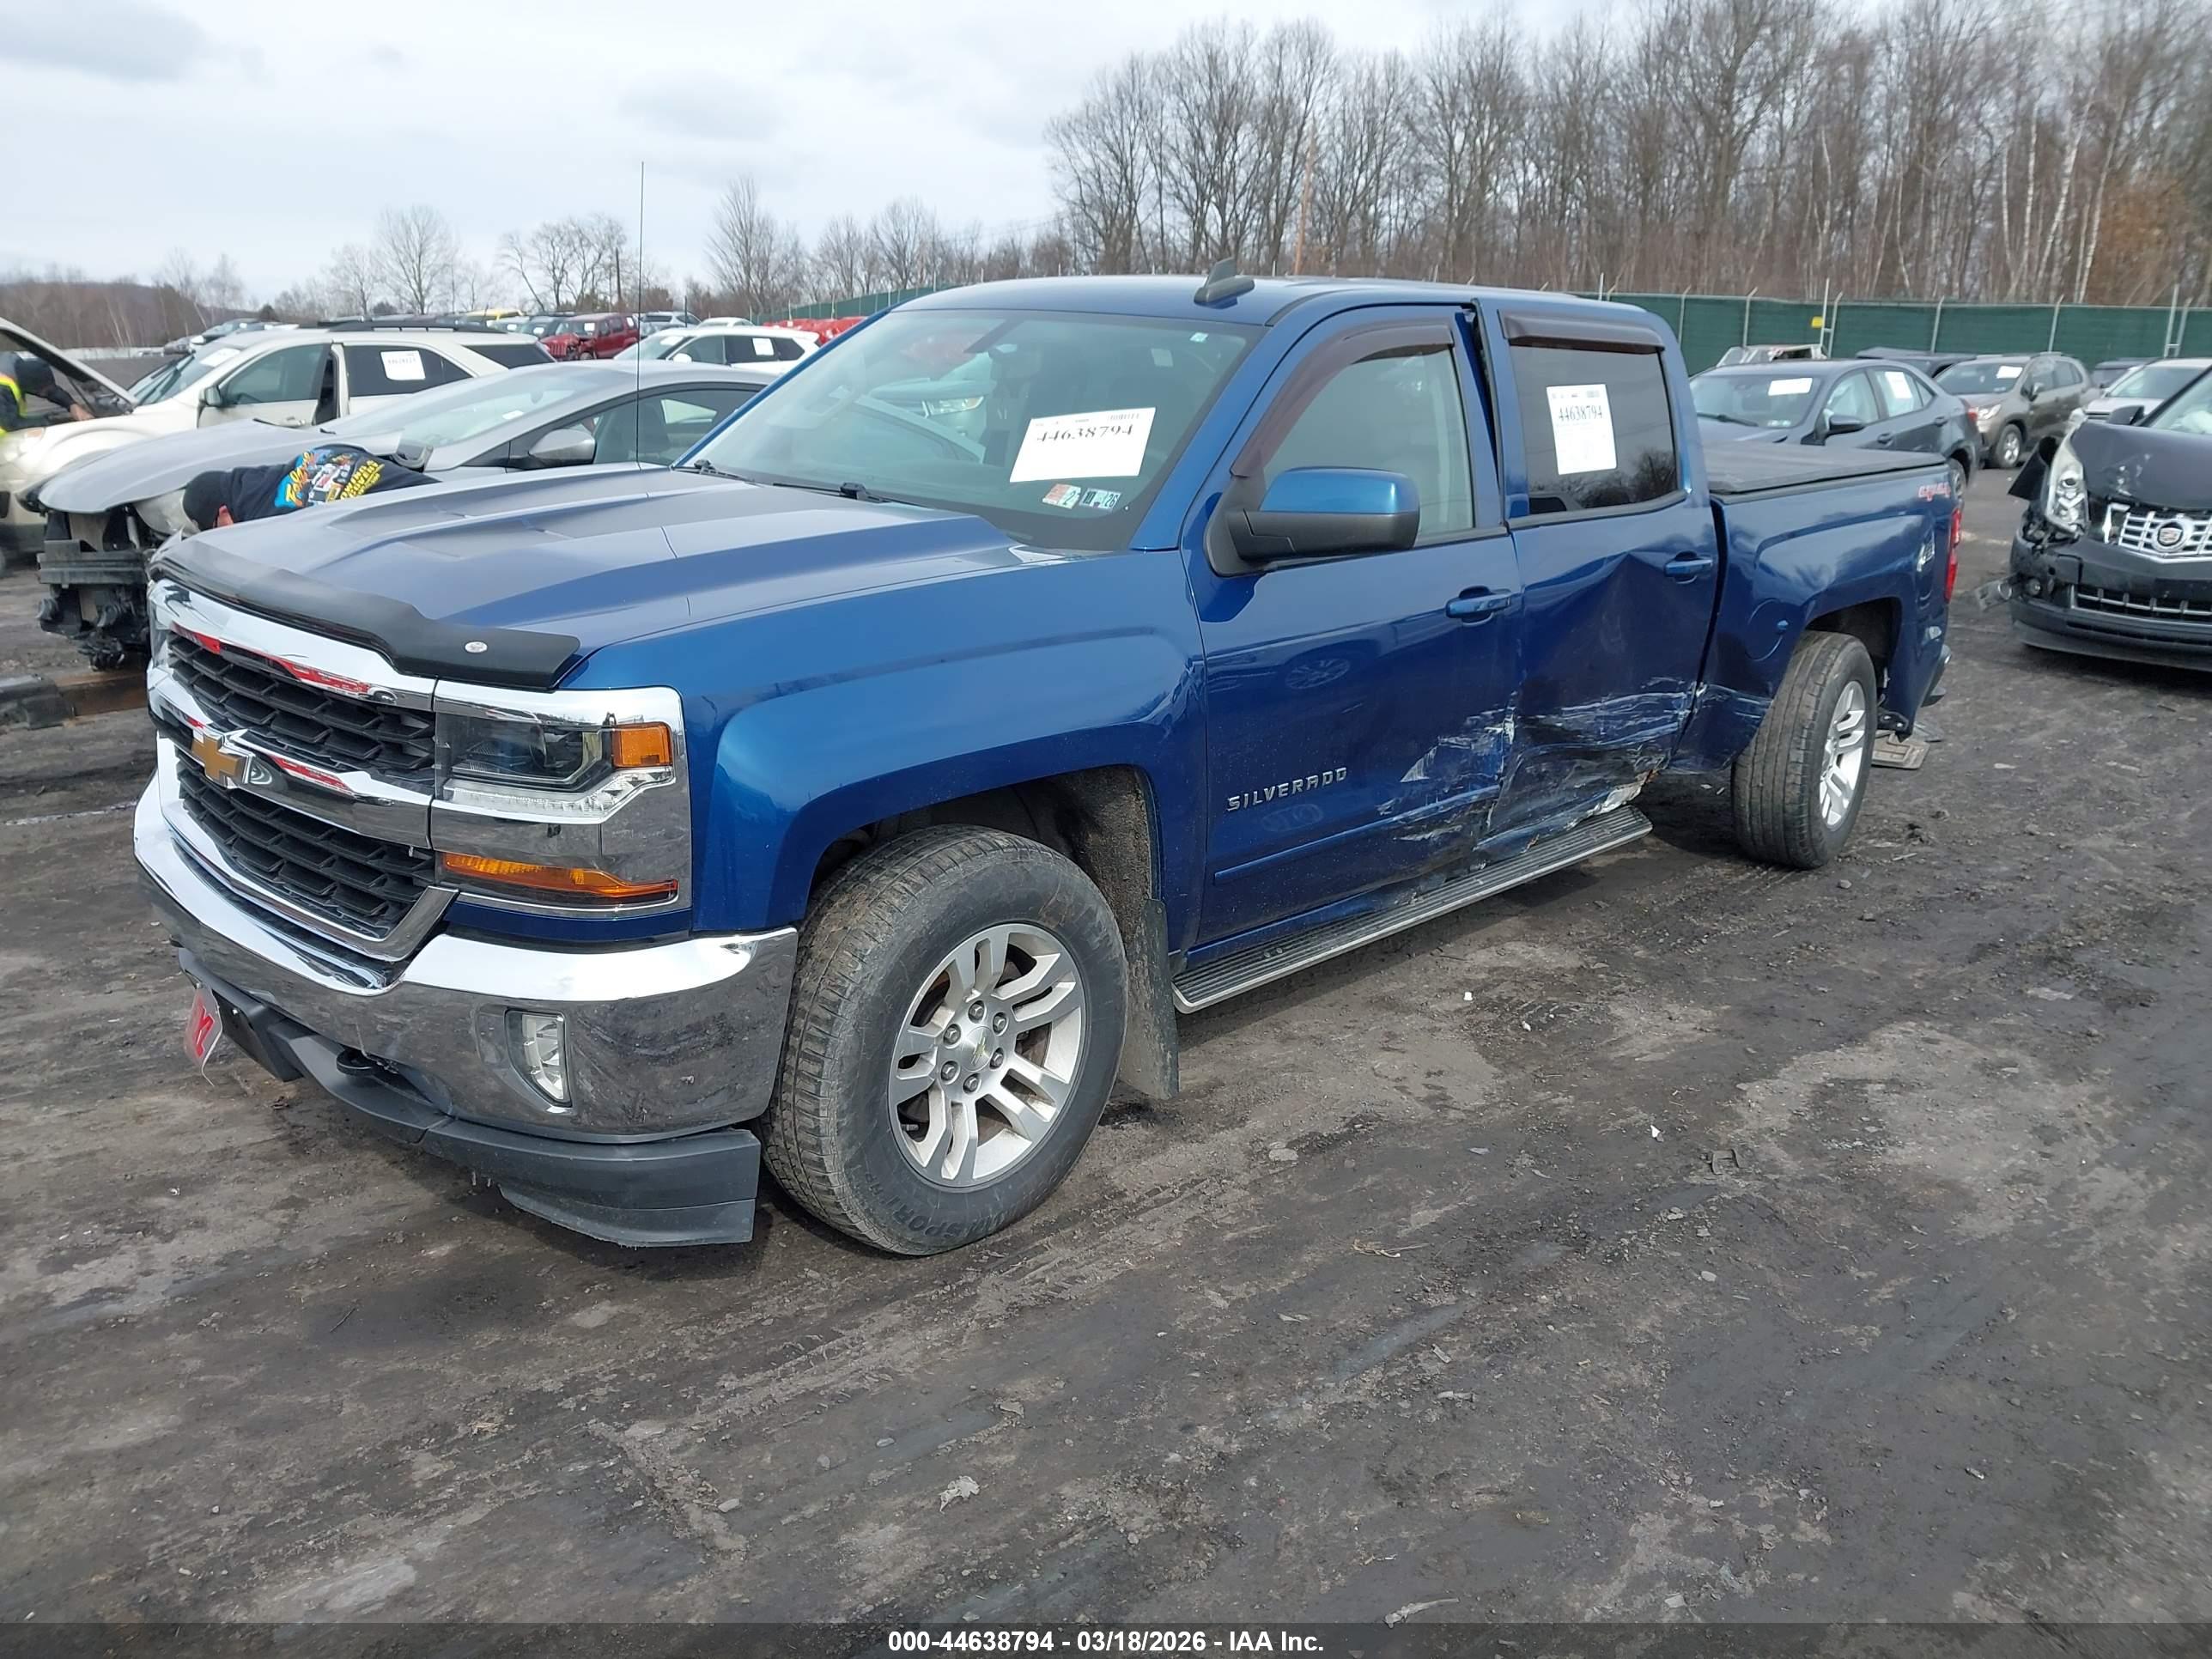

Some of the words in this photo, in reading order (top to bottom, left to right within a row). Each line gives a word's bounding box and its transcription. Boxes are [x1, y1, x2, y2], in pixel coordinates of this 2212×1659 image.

[1559, 404, 1602, 421] 44638794
[1036, 424, 1133, 442] 44638794
[1226, 766, 1348, 811] SILVERADO
